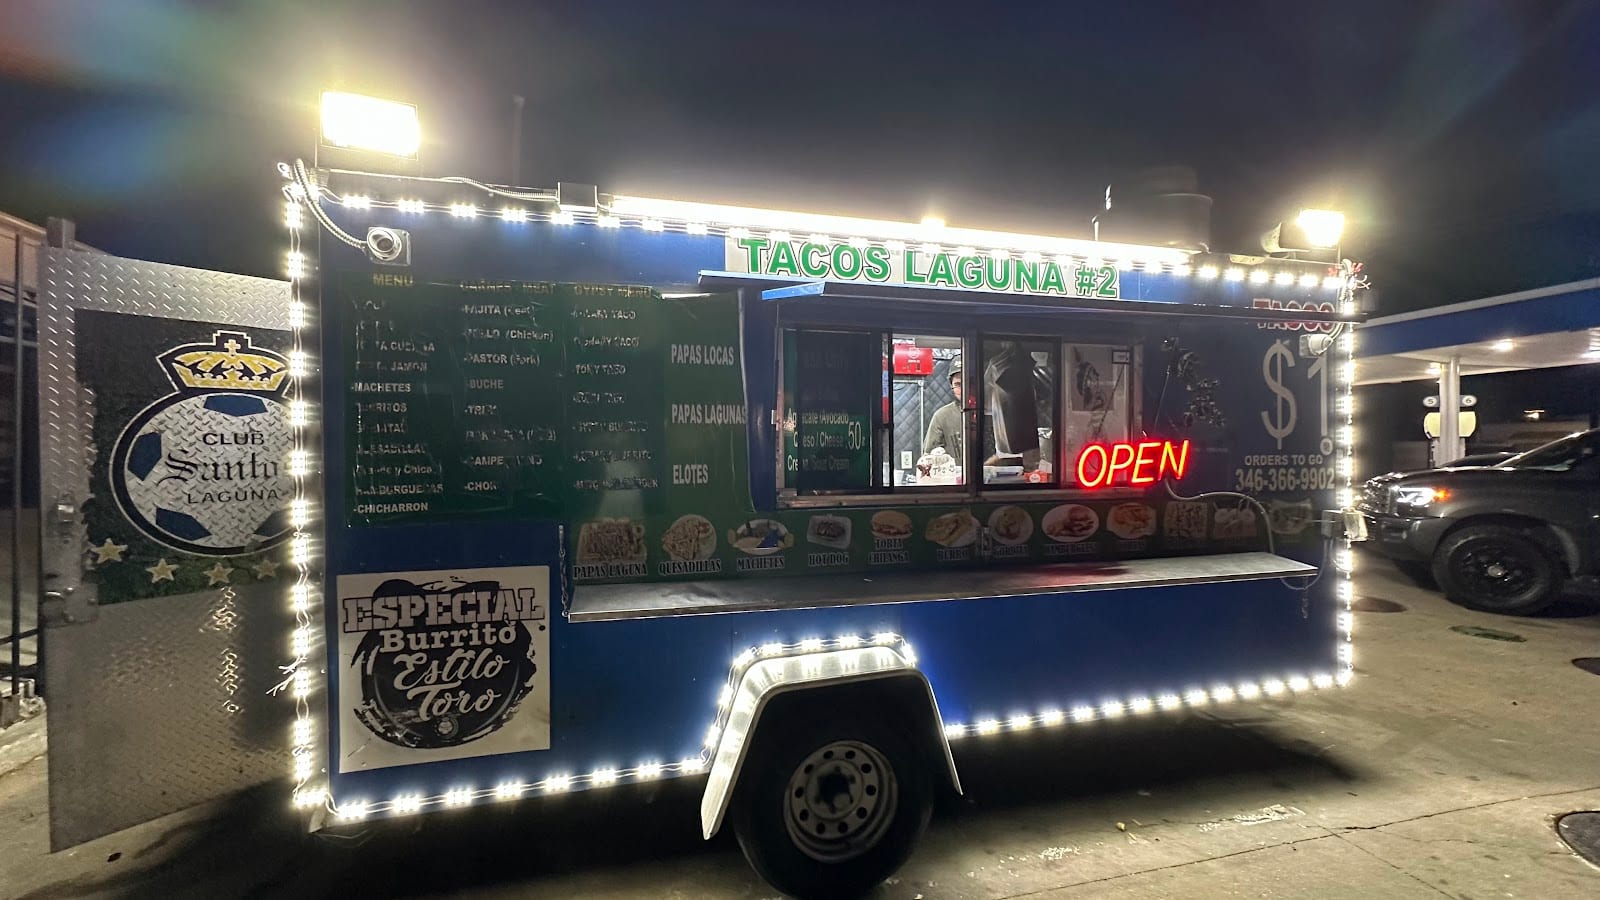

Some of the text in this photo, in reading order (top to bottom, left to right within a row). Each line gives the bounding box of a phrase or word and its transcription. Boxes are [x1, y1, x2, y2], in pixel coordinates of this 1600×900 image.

[738, 237, 1117, 297] TACOS LAGUNA #2
[373, 273, 414, 287] MENU
[671, 344, 735, 365] PAPAS LOCAS
[671, 404, 702, 424] PAPAS
[203, 433, 265, 446] CLUB
[1078, 439, 1190, 487] OPEN
[1244, 454, 1324, 466] ORDERS TO GO
[673, 464, 709, 485] ELOTES
[1235, 468, 1335, 491] 346-366-9902
[187, 489, 281, 504] LAGUNA
[573, 562, 647, 579] PAPAS LAGUNA
[658, 559, 721, 575] QUESADILLAS
[343, 588, 546, 633] ESPECIAL
[379, 622, 518, 654] Burrito
[393, 648, 510, 690] Estilo
[406, 680, 502, 721] Toro
